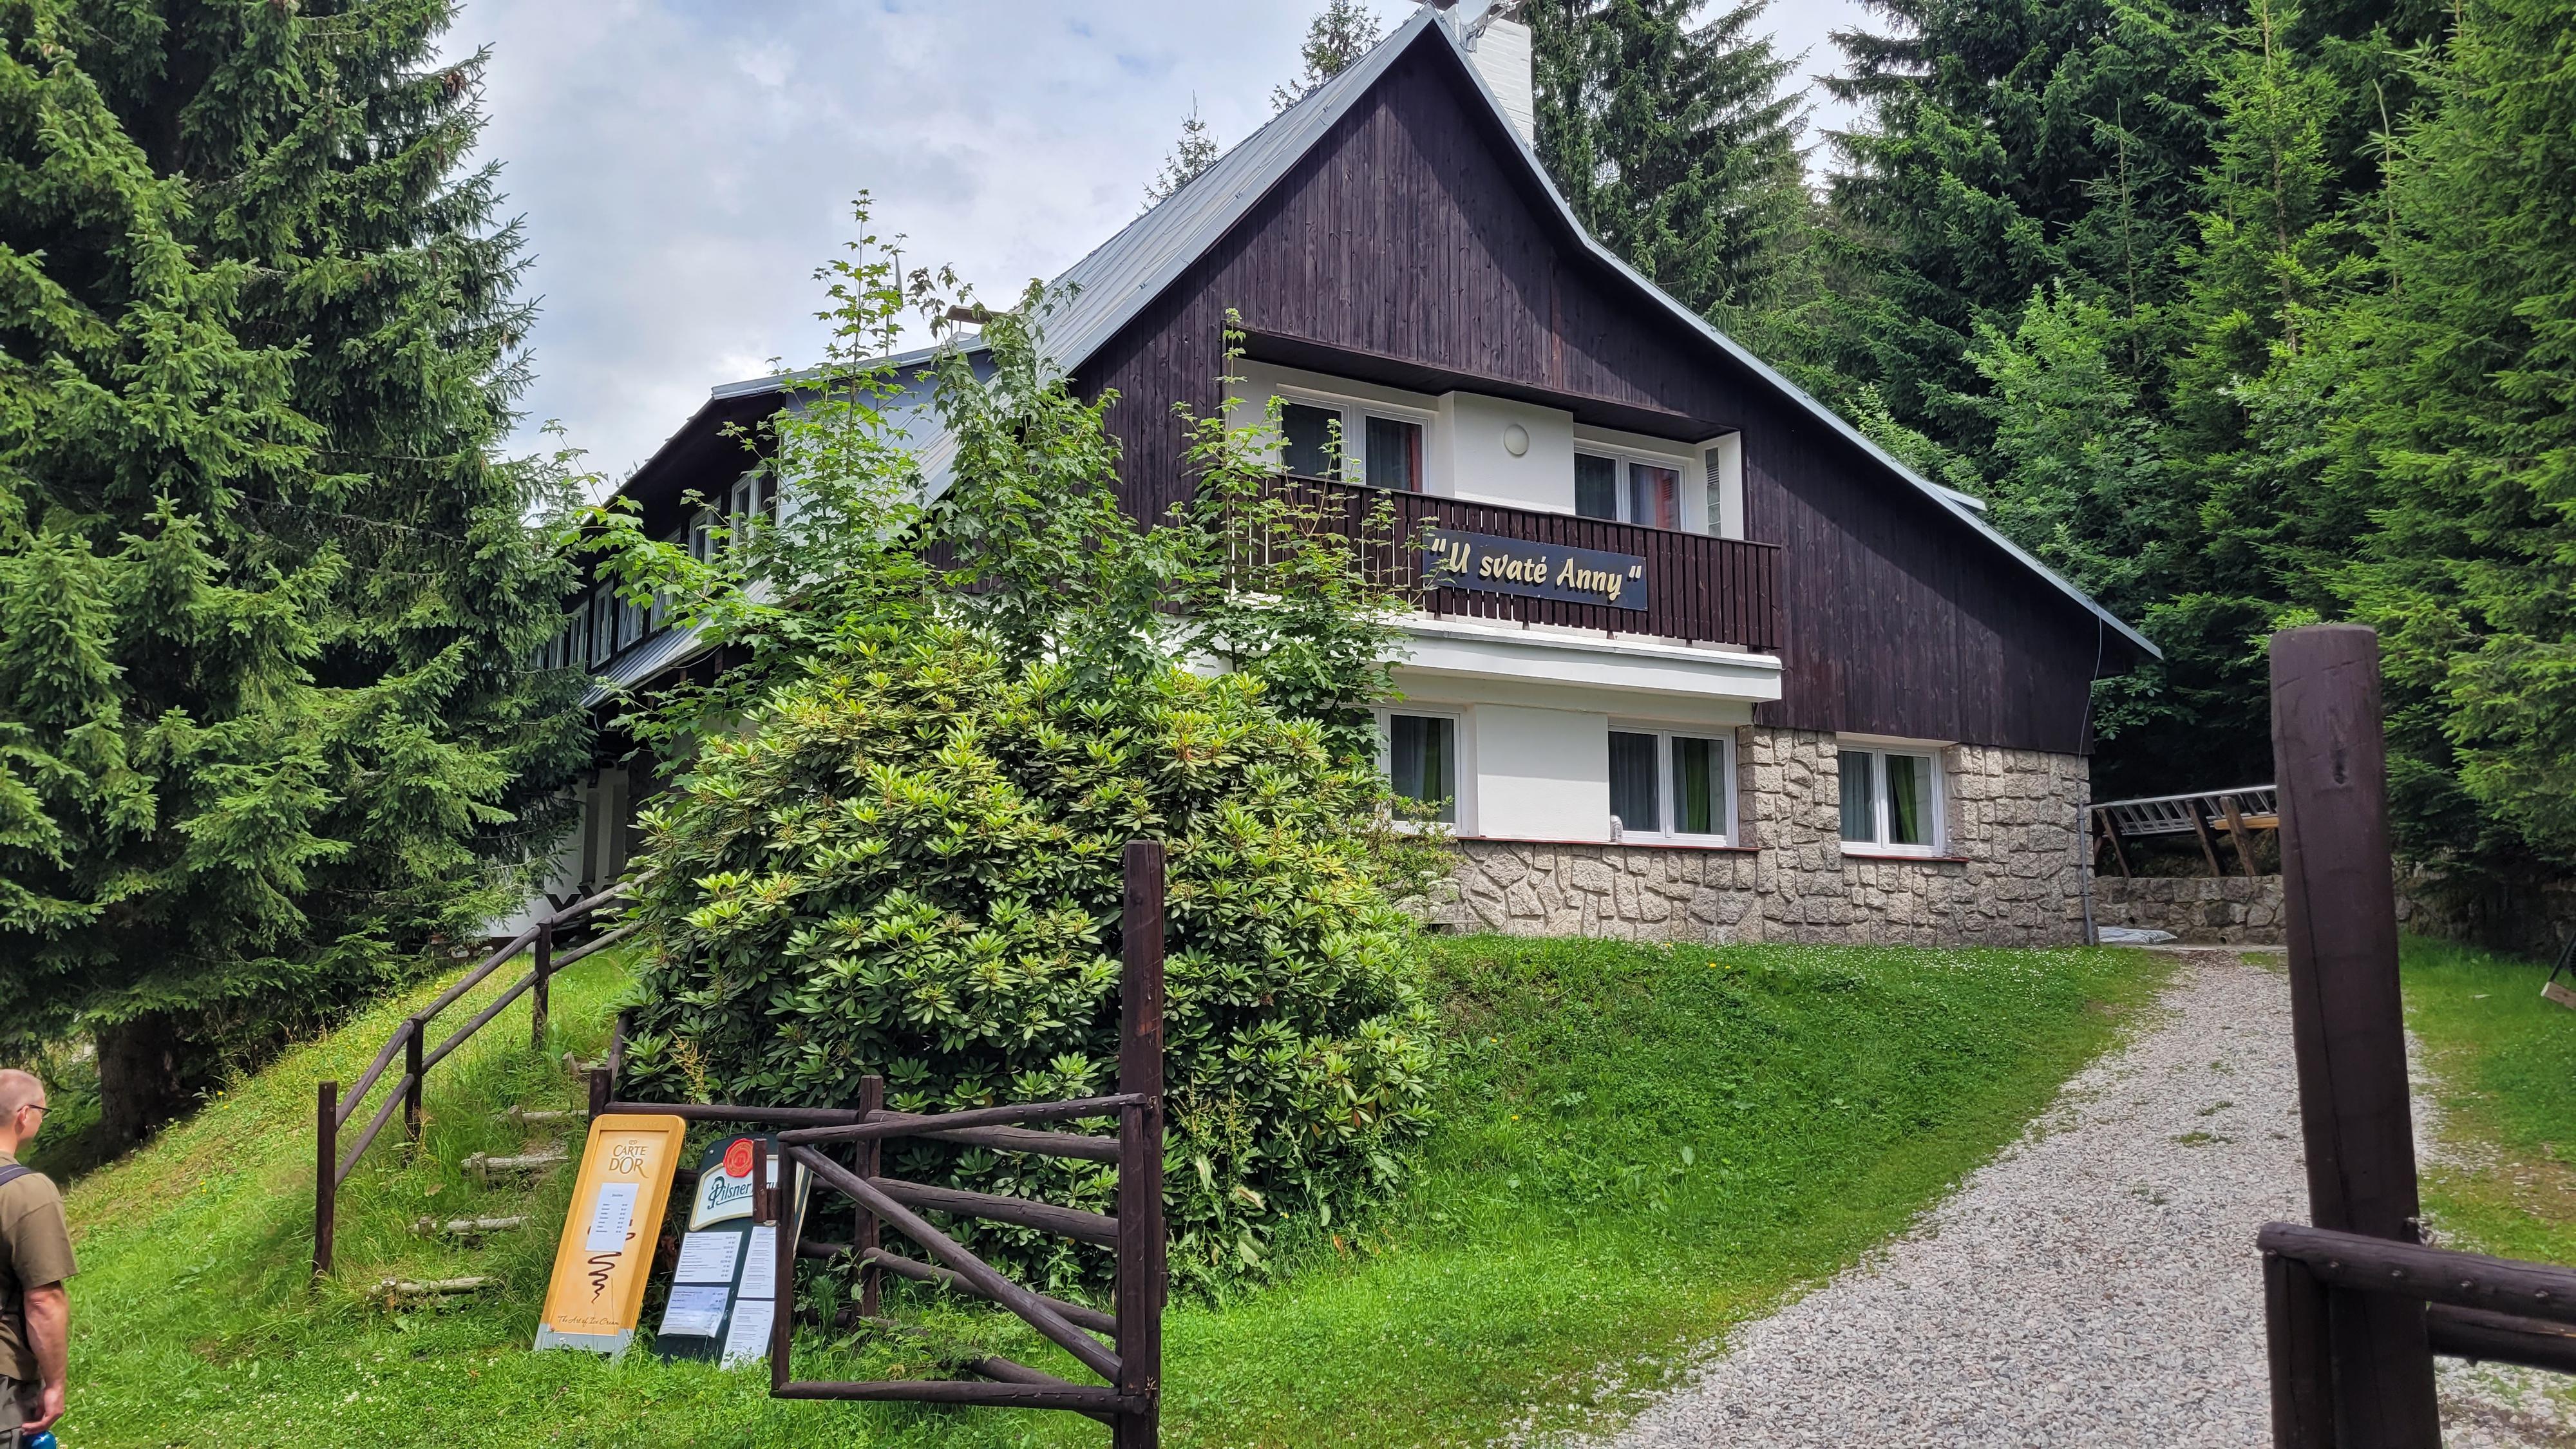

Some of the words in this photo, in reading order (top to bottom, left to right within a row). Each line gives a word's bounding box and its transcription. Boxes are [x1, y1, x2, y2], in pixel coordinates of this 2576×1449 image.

[1479, 554, 1547, 583] svaté
[613, 1144, 649, 1158] CARTE
[609, 1156, 649, 1179] D'OR
[707, 1176, 752, 1209] Pilsner
[568, 1316, 581, 1324] Art
